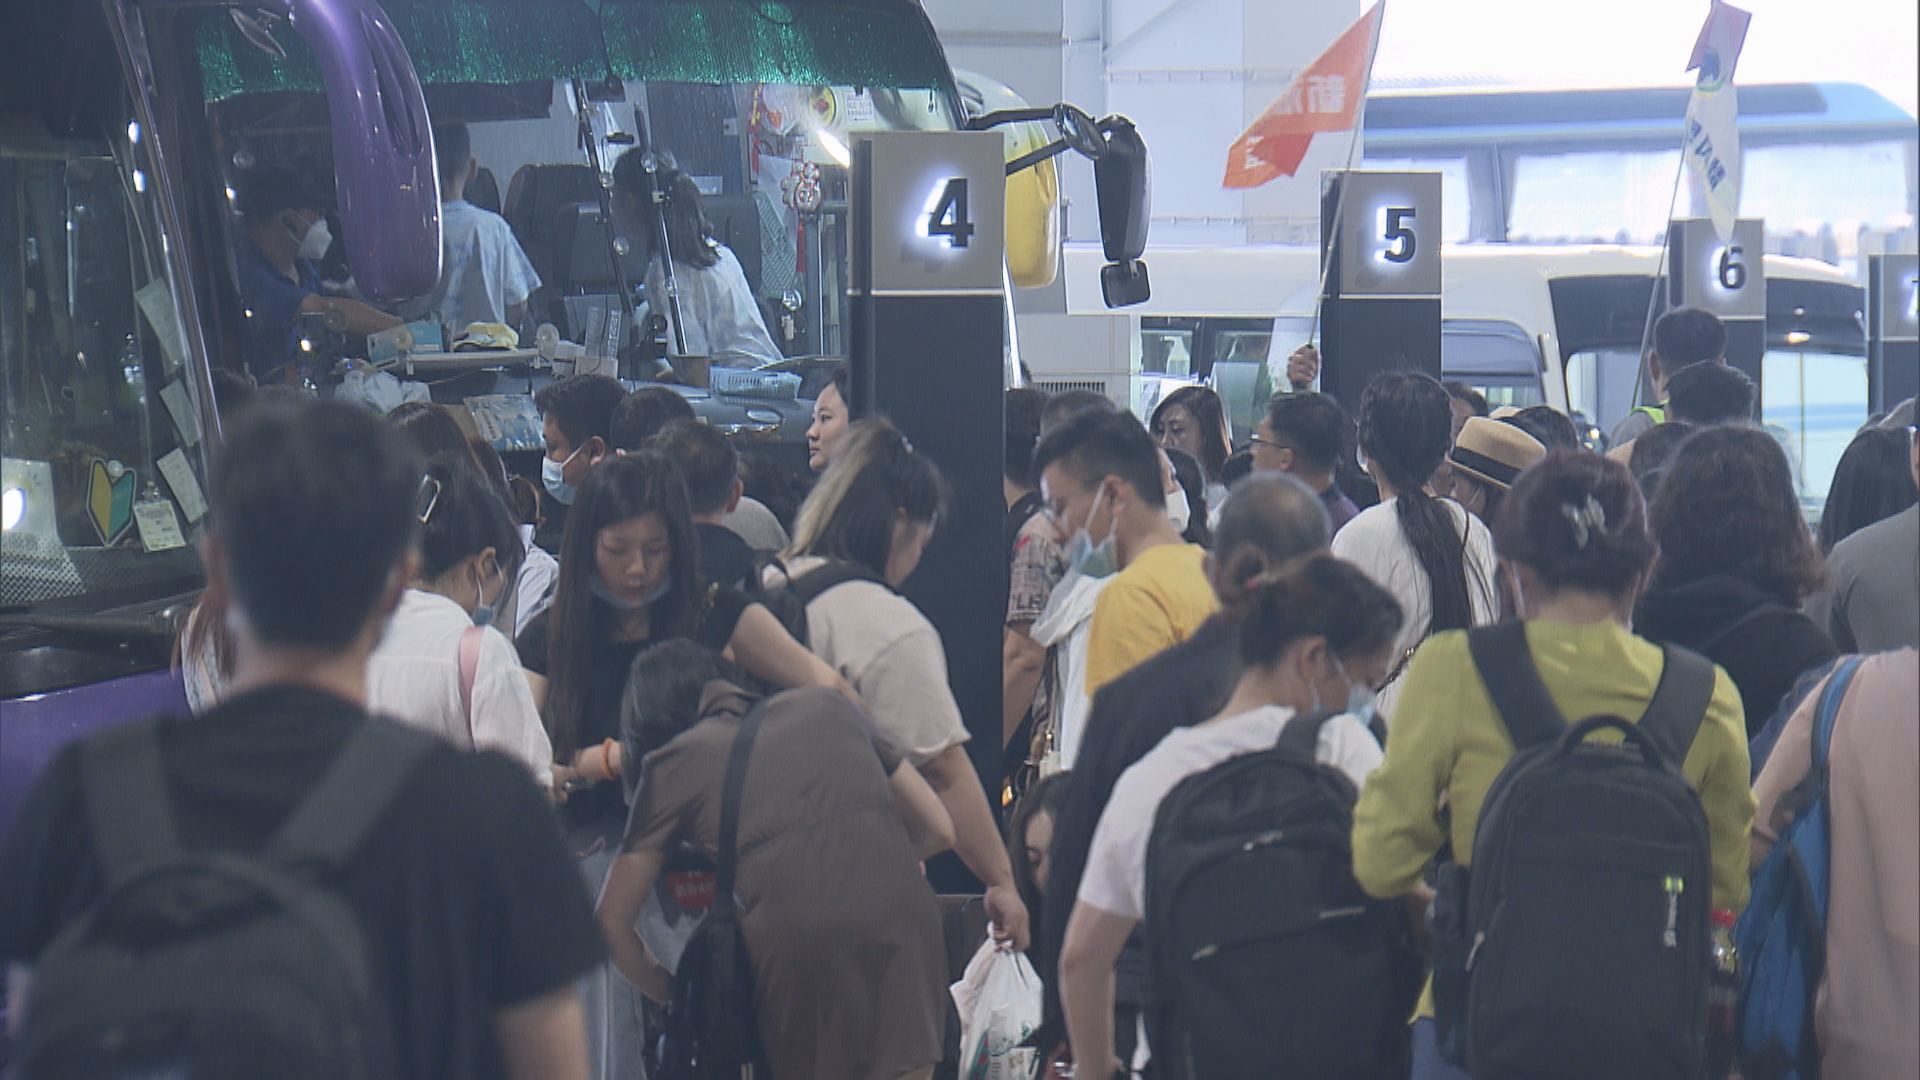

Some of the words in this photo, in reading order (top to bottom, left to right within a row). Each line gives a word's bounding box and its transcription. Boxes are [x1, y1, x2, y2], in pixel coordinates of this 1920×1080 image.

[928, 177, 974, 248] 4
[1384, 207, 1417, 263] 5
[1719, 245, 1746, 289] 6
